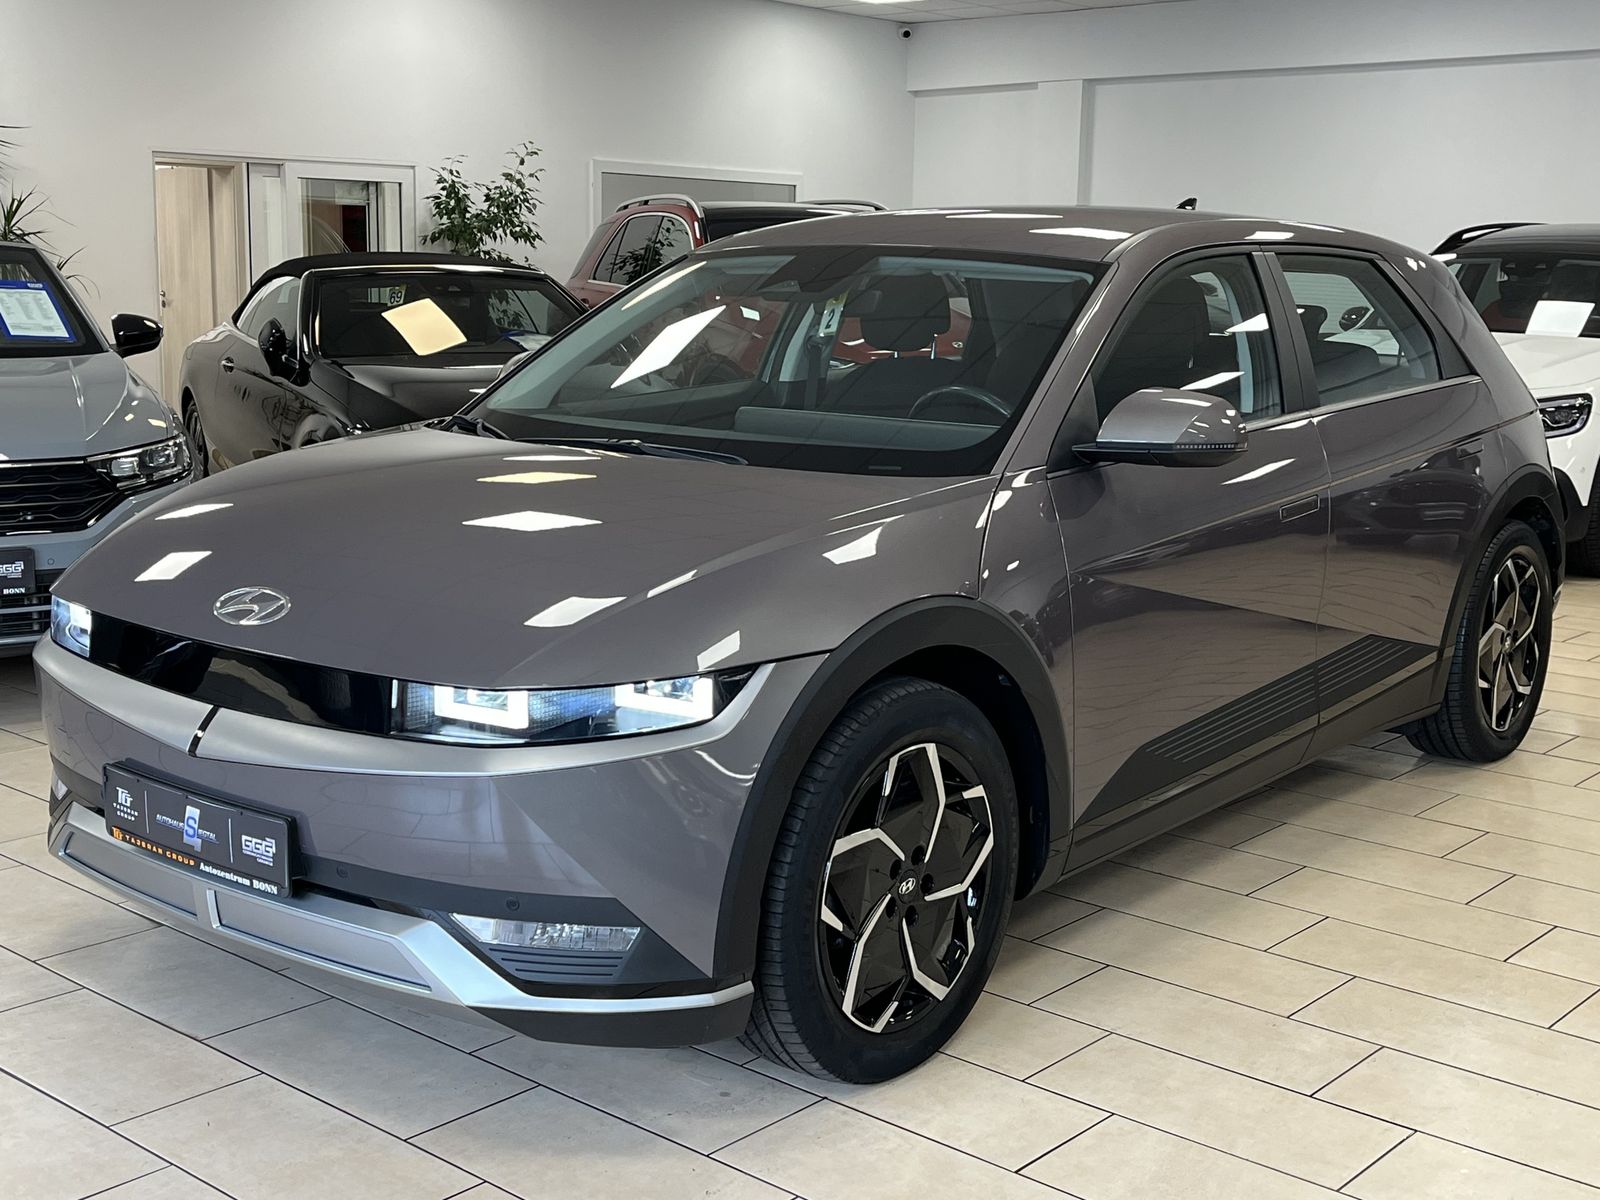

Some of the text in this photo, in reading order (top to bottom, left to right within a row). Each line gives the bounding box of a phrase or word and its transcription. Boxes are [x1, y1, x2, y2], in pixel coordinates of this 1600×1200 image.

[390, 291, 402, 304] 69
[824, 308, 835, 329] 2
[156, 814, 184, 828] AUTOHAUS
[241, 834, 275, 858] GGG
[165, 850, 195, 866] GROUP
[199, 862, 250, 886] Autozentrum
[252, 879, 278, 895] BONN
